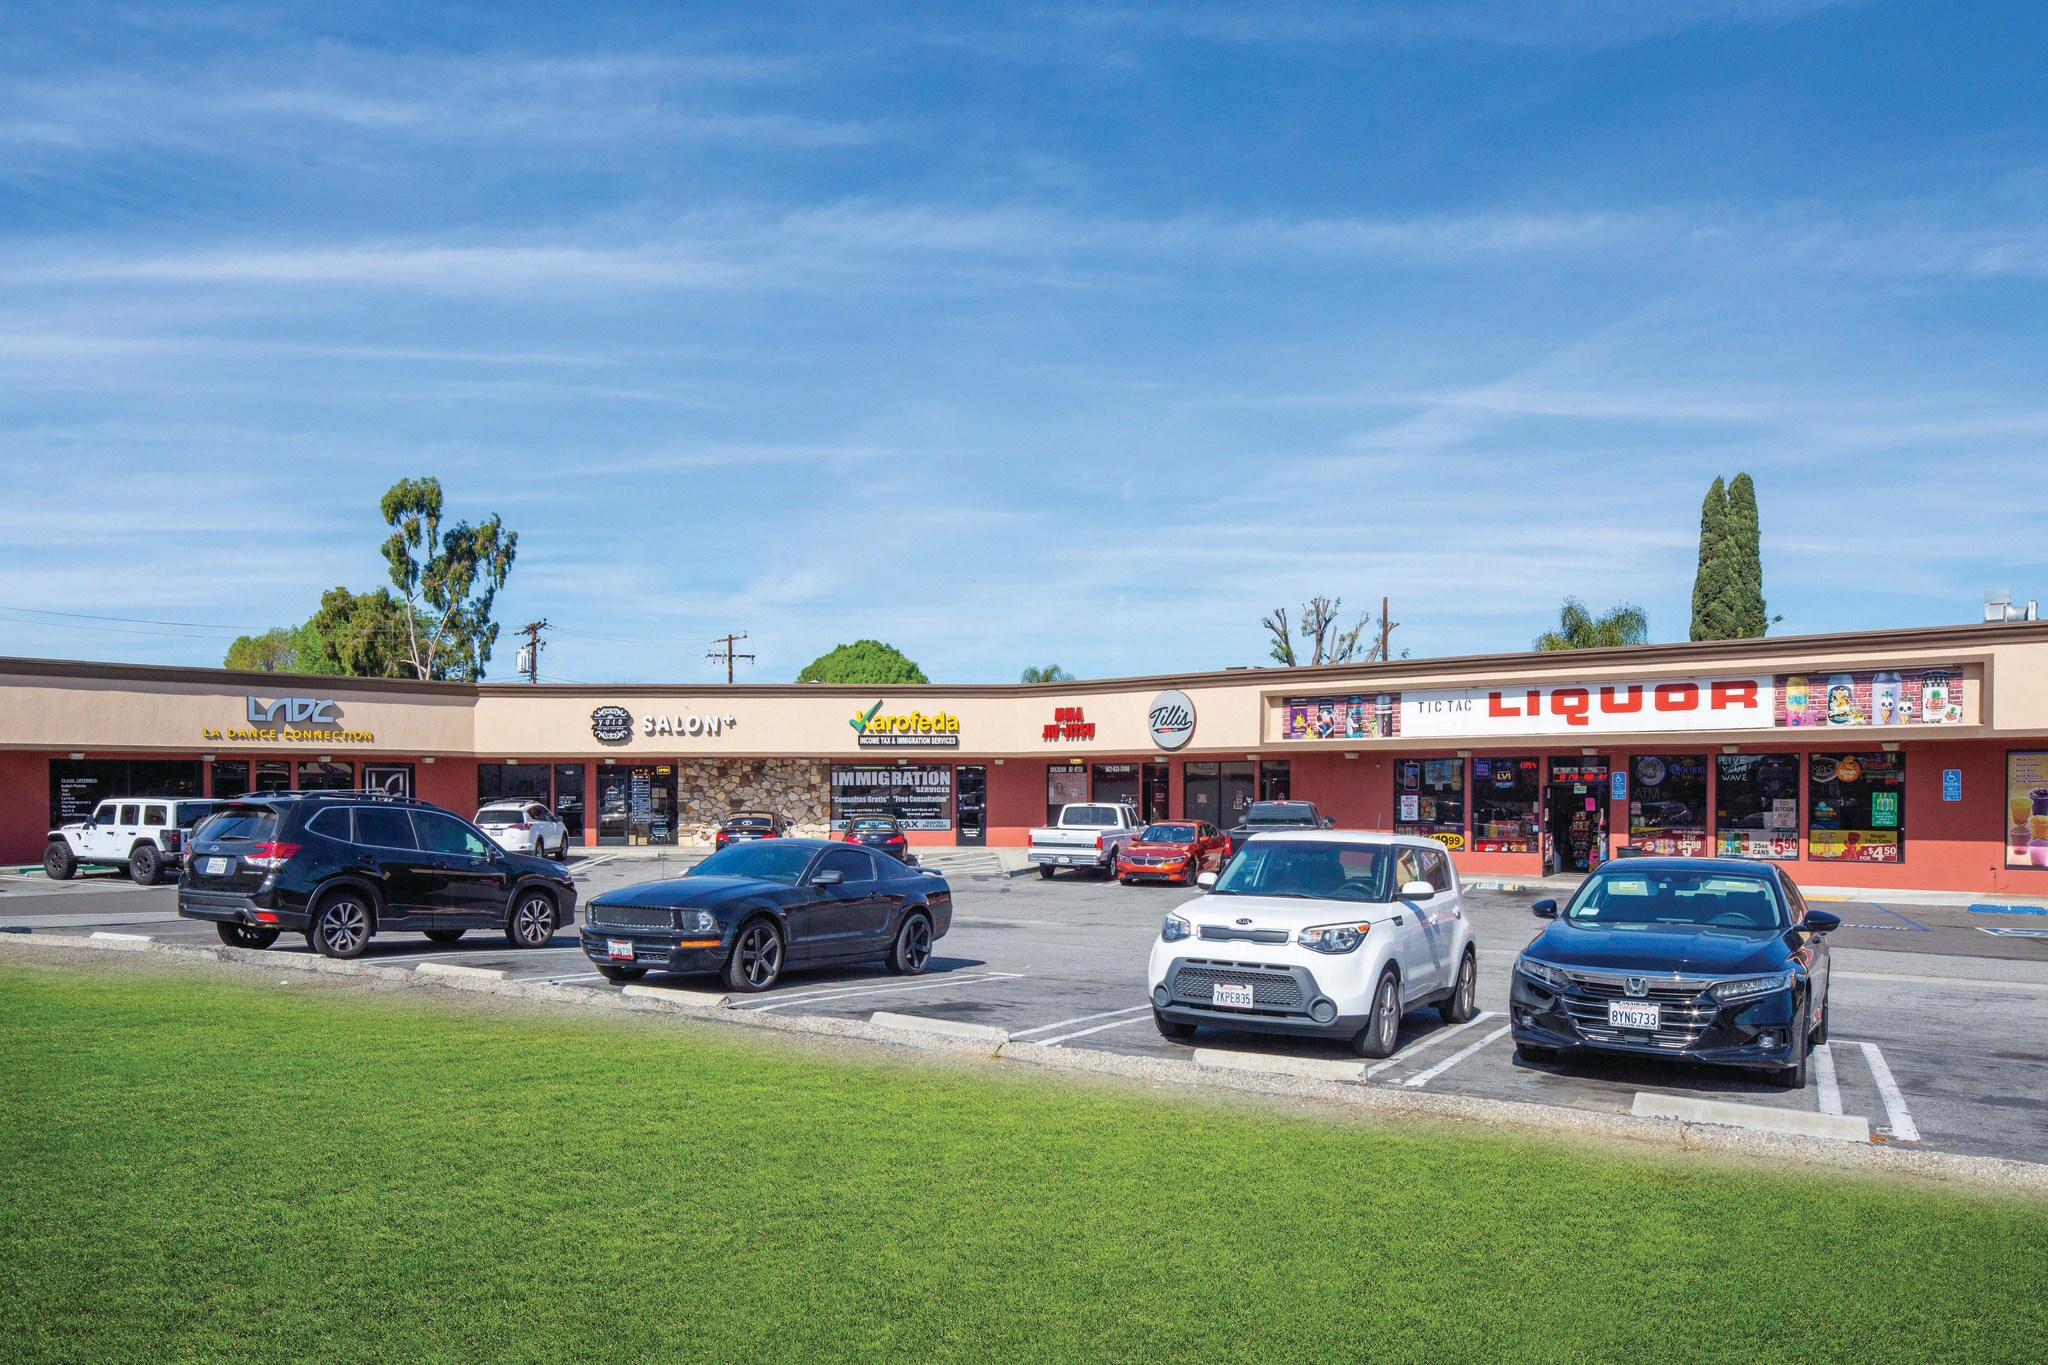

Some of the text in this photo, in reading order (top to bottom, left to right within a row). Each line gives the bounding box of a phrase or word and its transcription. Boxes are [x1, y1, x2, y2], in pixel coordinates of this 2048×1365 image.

[1419, 699, 1472, 713] TIC TAC
[1488, 680, 1758, 726] LIQUOR
[1054, 707, 1083, 721] MMA
[1149, 705, 1192, 728] Tillis
[202, 728, 373, 740] LA DANCE CONNECTION
[1042, 723, 1095, 739] JIU-JITSU
[1670, 764, 1705, 774] Corona
[1812, 764, 1834, 774] 805
[831, 772, 950, 786] IMMIGRATION
[1634, 788, 1660, 800] ATM
[1216, 991, 1250, 1004] 7KPE835
[1612, 1010, 1657, 1026] 8YNG733
